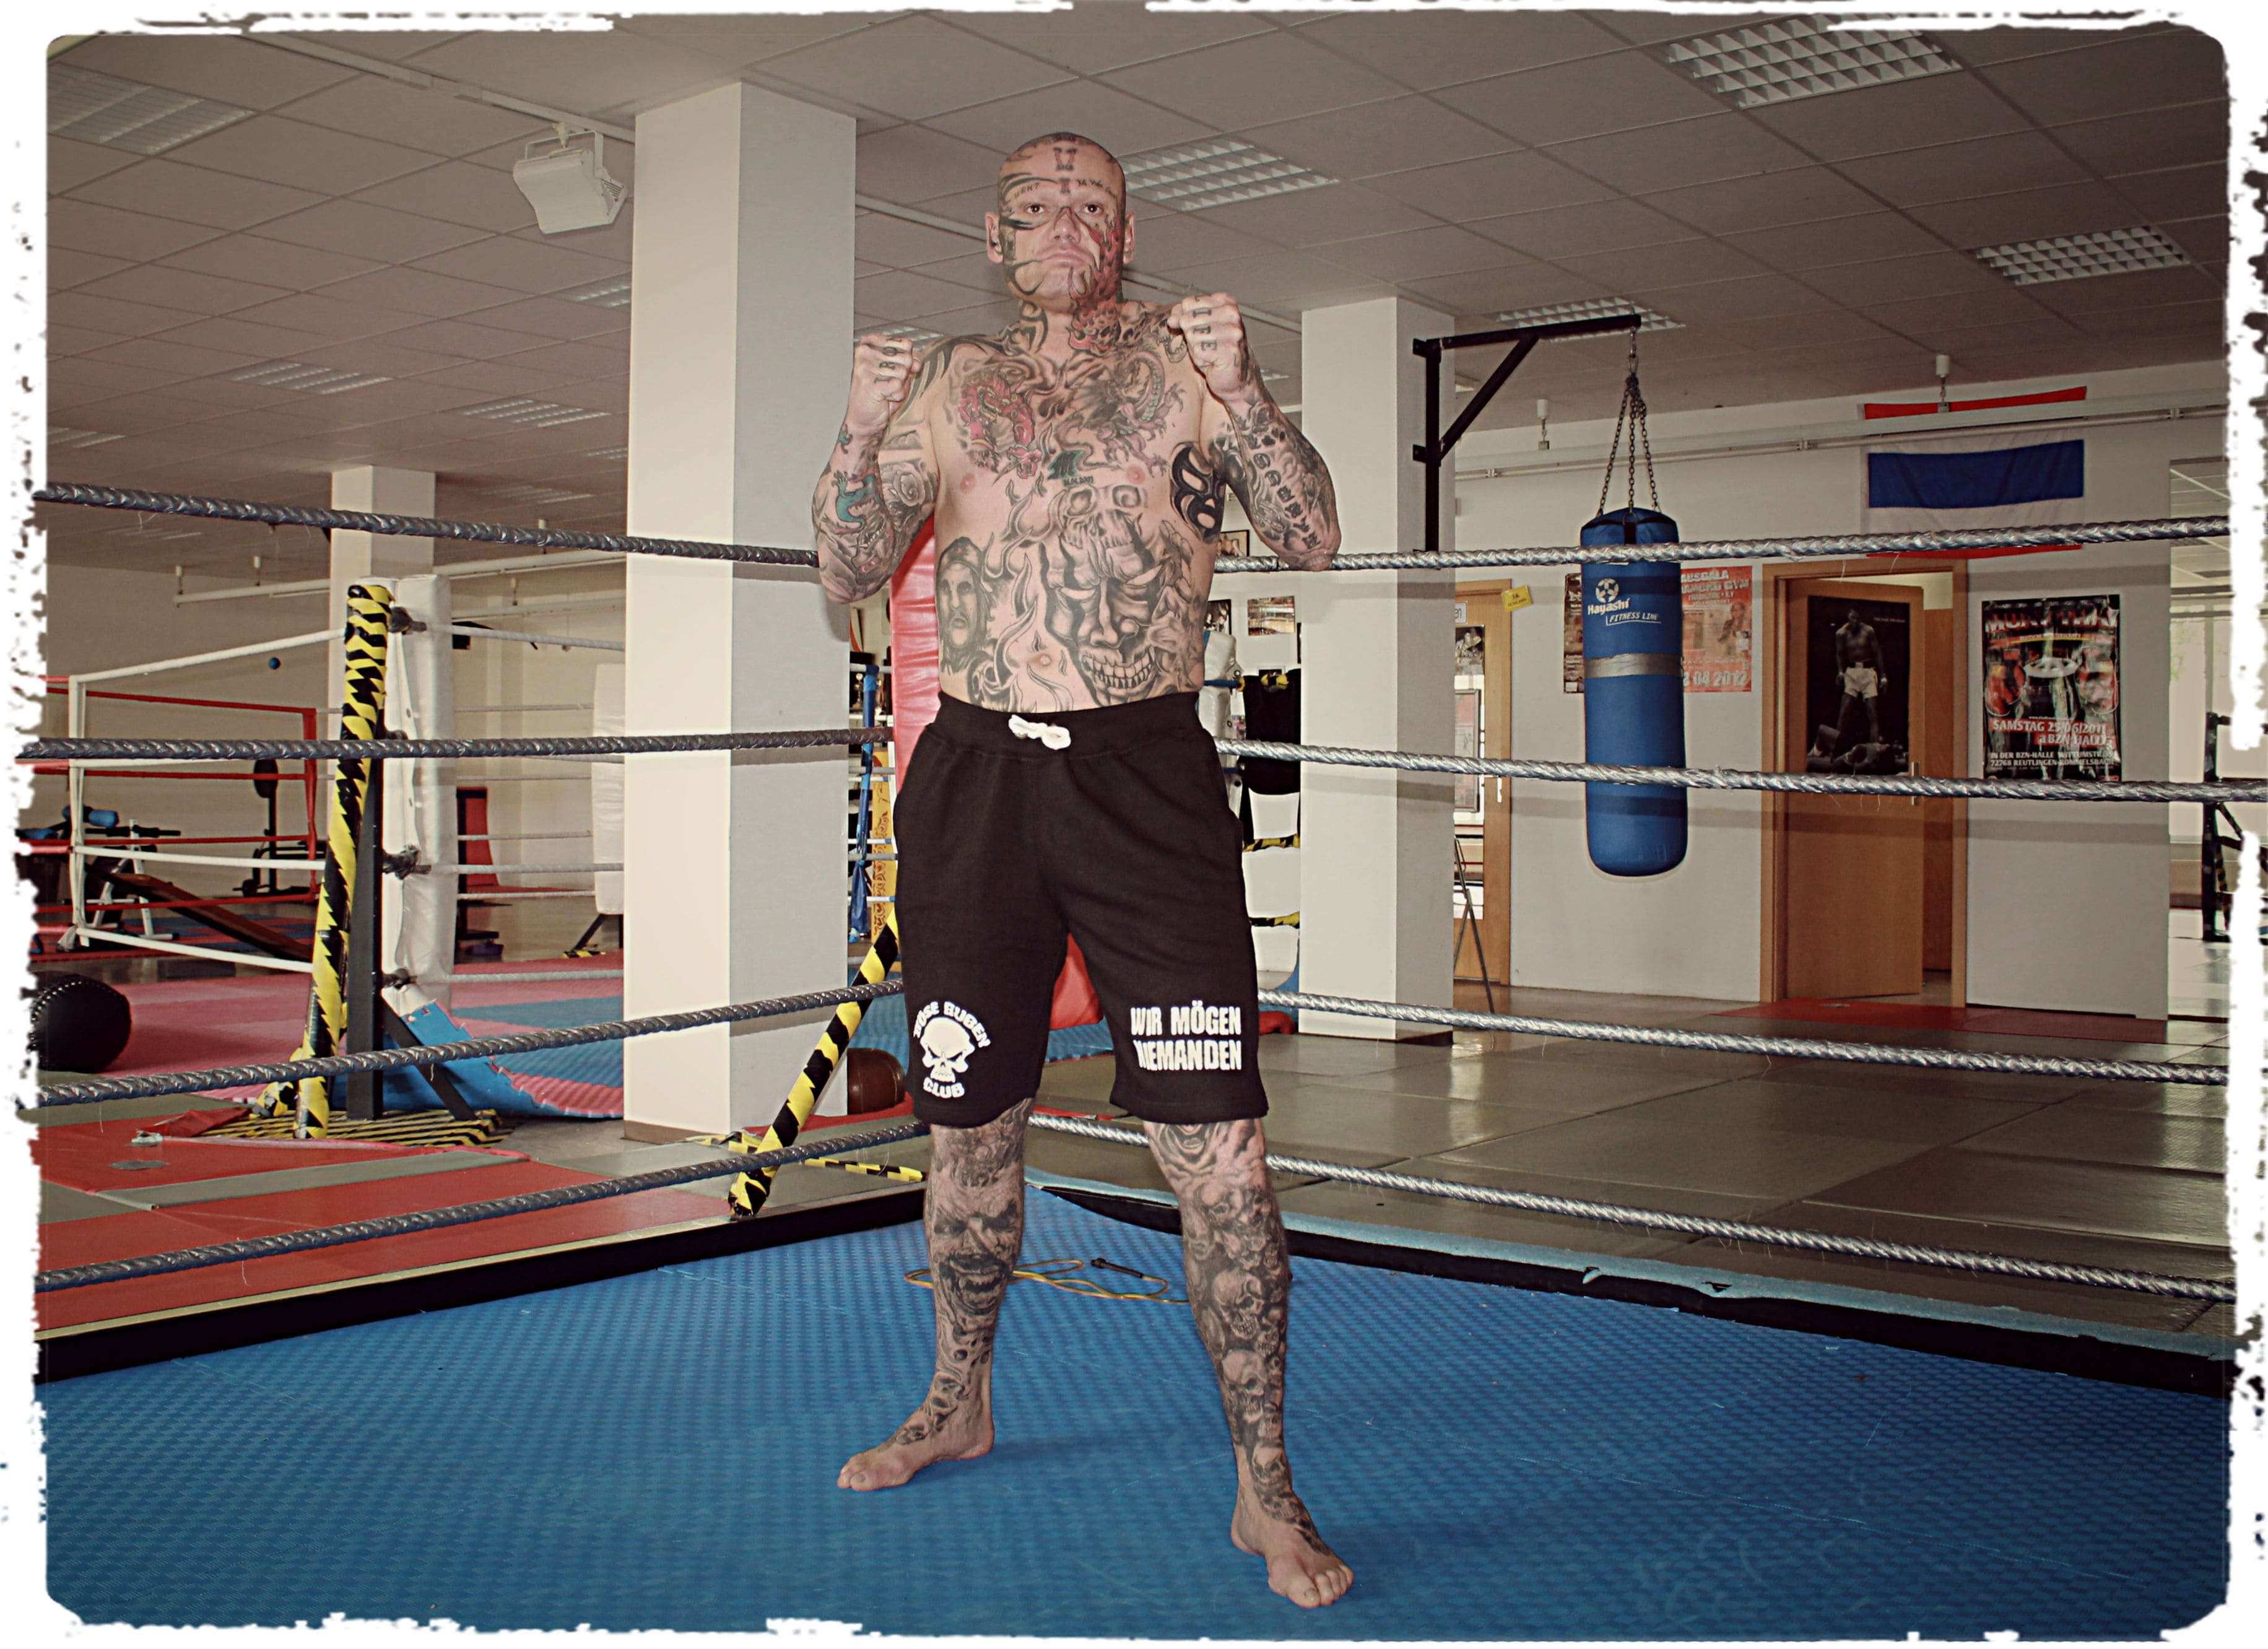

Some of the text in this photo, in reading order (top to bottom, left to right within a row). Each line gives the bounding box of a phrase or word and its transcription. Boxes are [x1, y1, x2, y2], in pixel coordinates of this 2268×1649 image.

[1588, 598, 1630, 615] Hayashi
[1610, 612, 1641, 622] FITNESS
[1993, 720, 2044, 732] SAMSTAG
[944, 1001, 991, 1048] BUBEN
[1131, 1000, 1241, 1036] WIR MÖGEN
[1133, 1040, 1242, 1071] NIEMANDEN
[923, 1077, 965, 1098] CLUB
